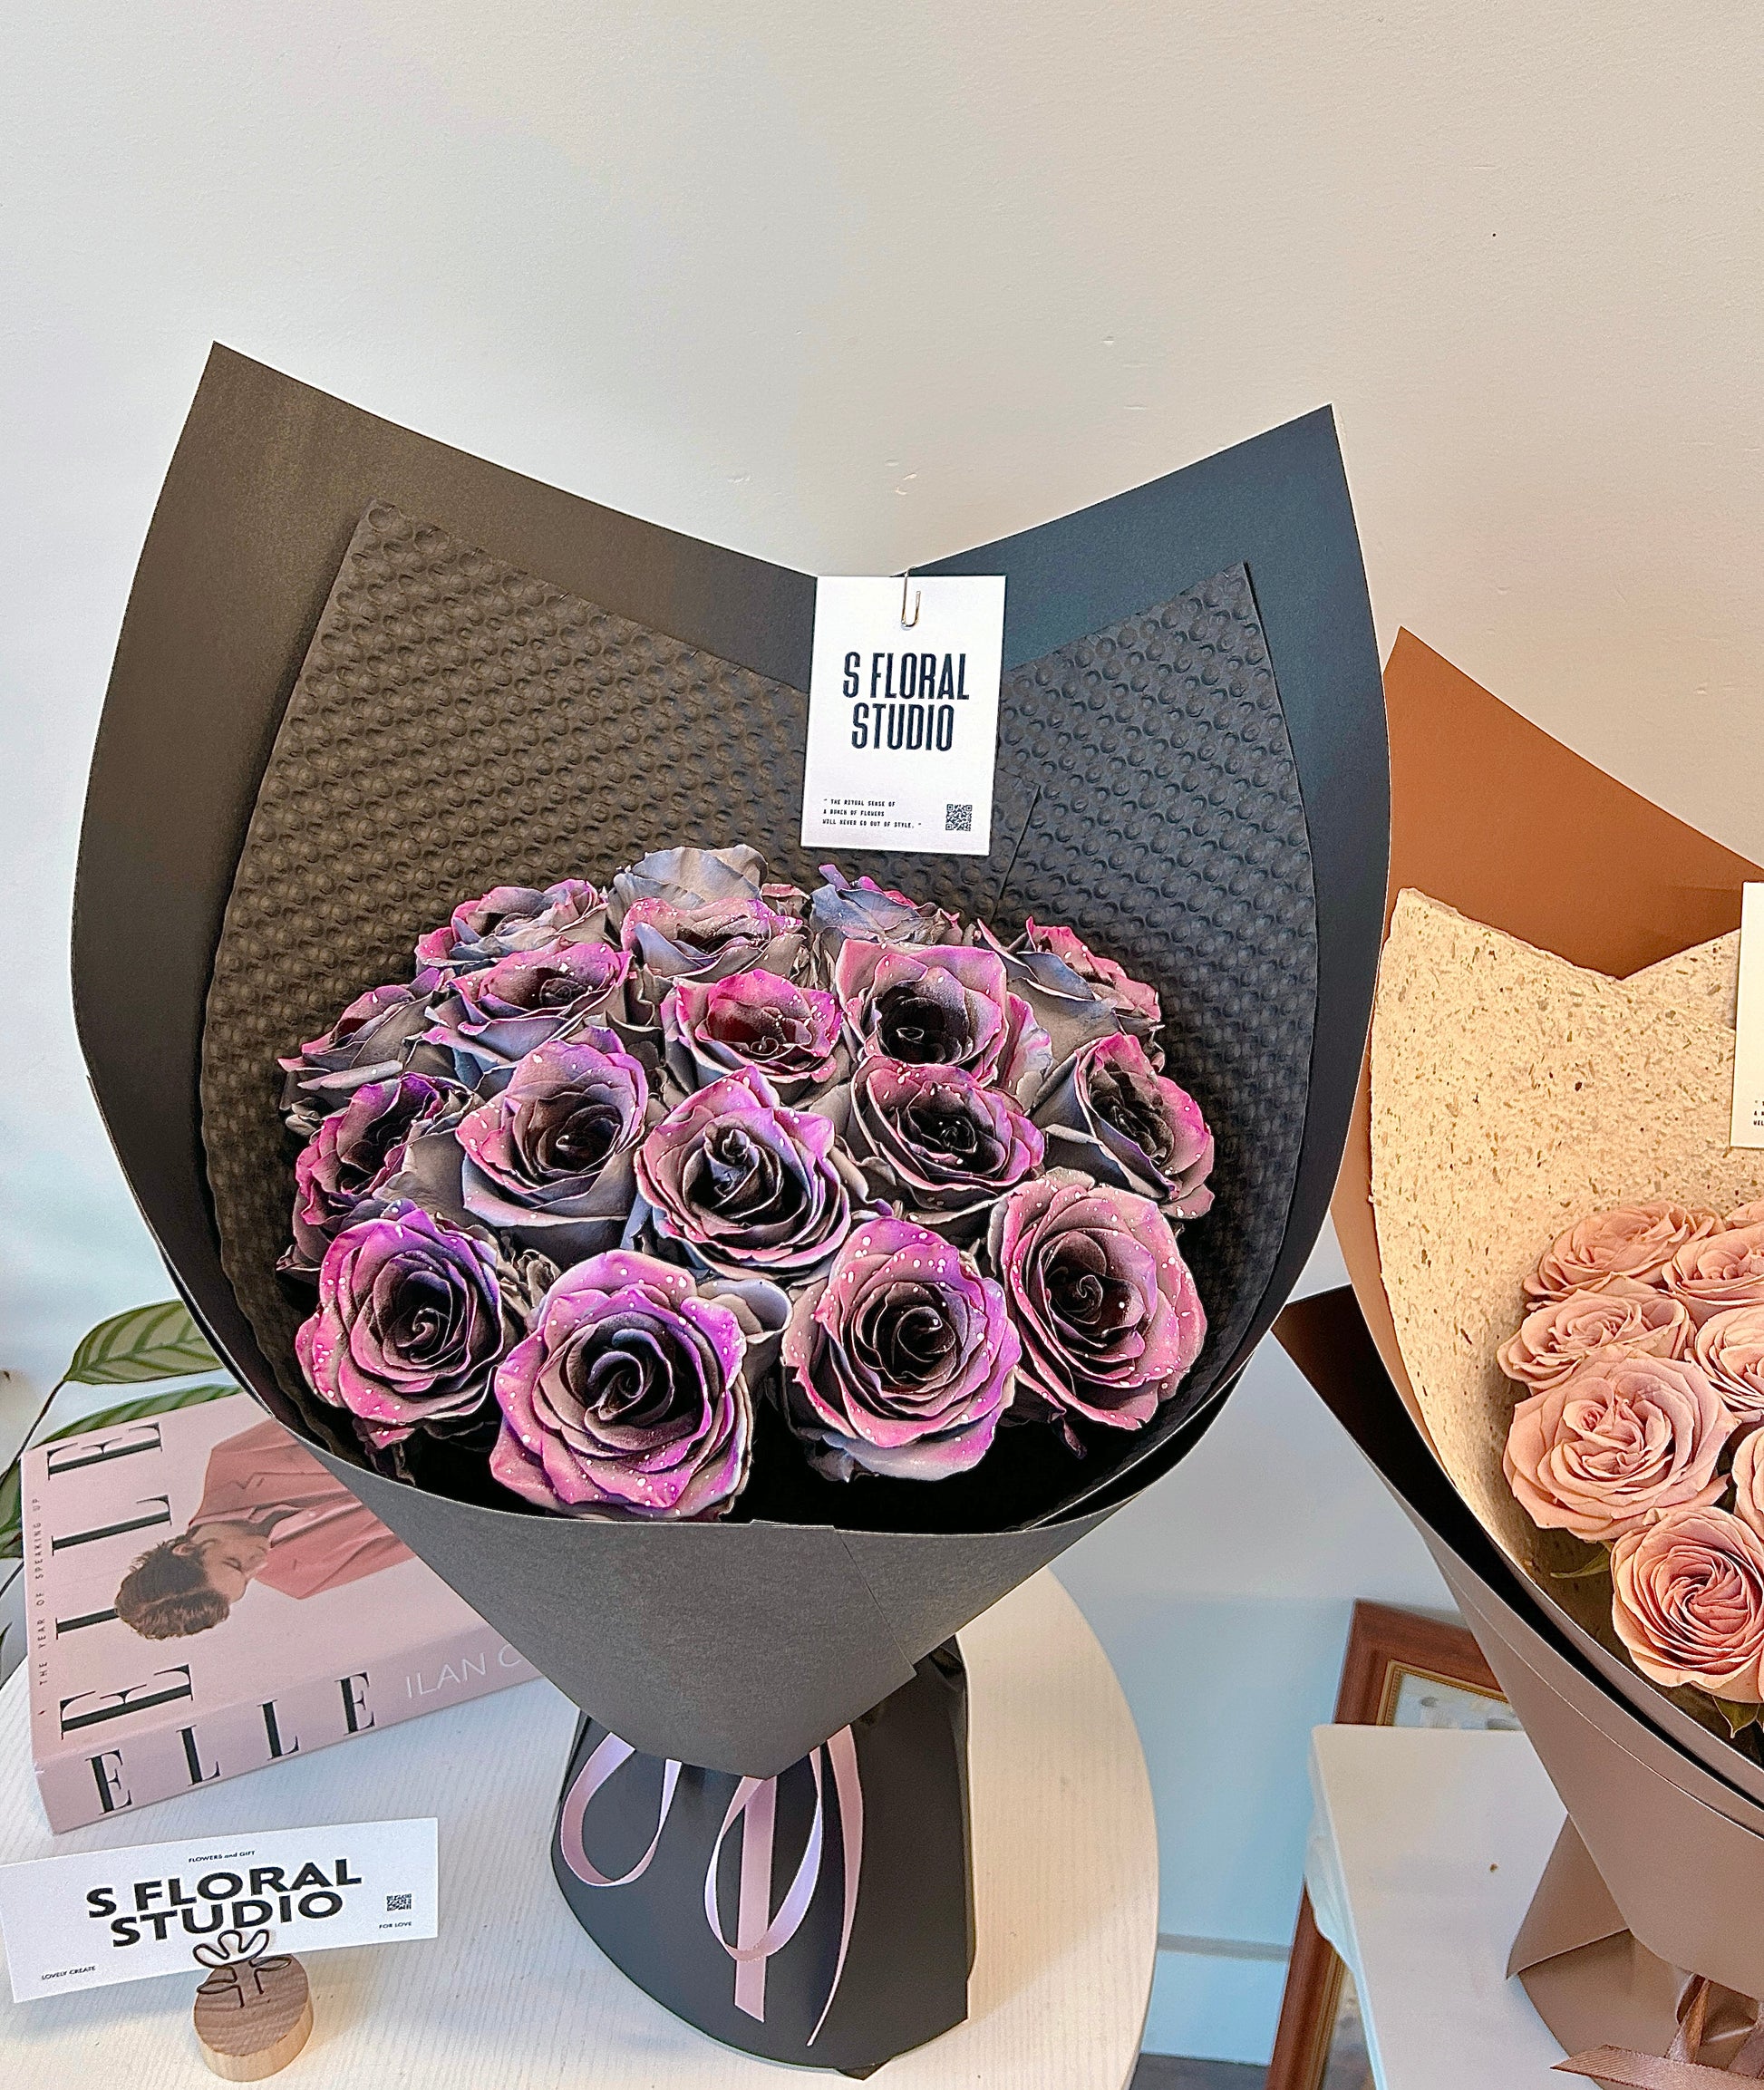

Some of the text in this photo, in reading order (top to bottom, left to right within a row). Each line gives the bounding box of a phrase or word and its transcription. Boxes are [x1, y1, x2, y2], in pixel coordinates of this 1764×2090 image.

[843, 652, 969, 700] S FLORAL
[851, 702, 955, 751] STUDIO
[32, 1498, 48, 1686] THE YEAR OF SPEAKING UP
[406, 1652, 486, 1698] ILAN
[86, 1671, 376, 1815] ELLE
[188, 1853, 223, 1863] FLOWERS
[86, 1858, 362, 1918] S FLORAL
[111, 1891, 344, 1948] STUDIO
